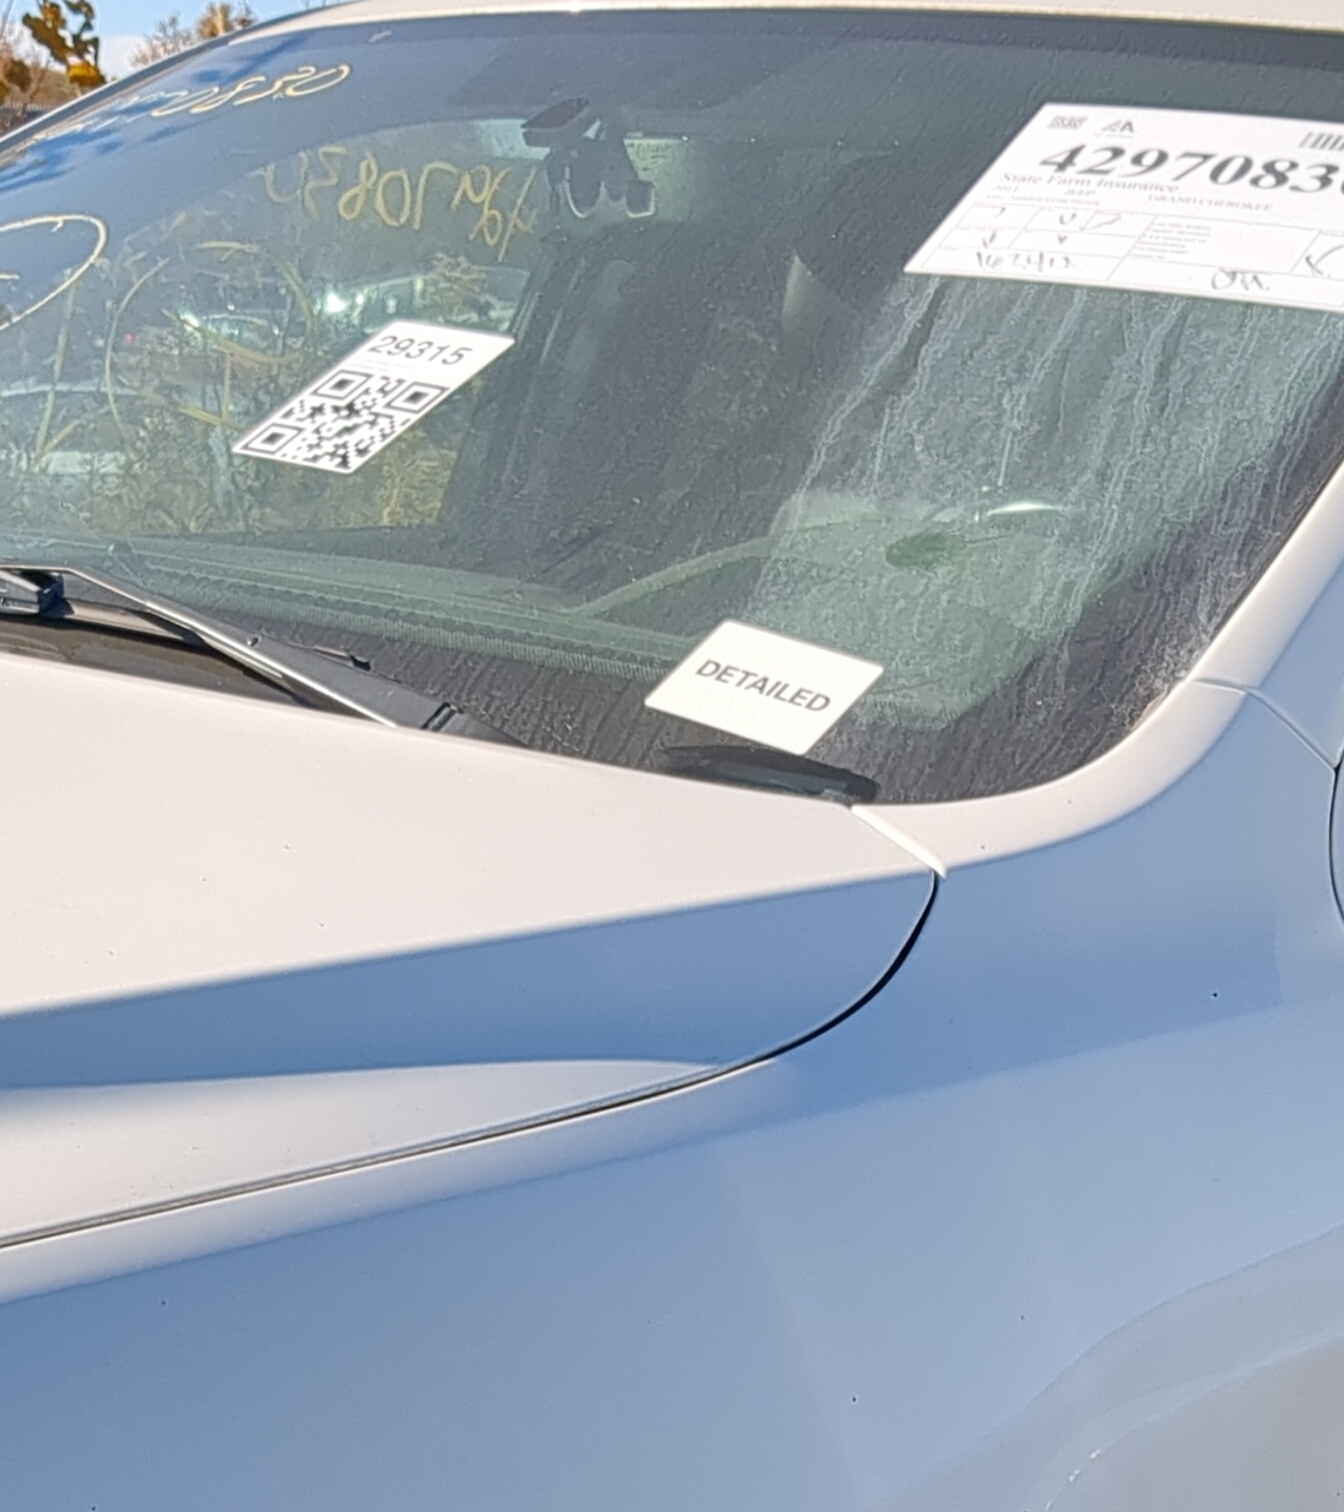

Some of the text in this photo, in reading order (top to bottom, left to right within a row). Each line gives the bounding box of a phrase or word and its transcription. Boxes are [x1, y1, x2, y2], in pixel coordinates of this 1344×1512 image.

[1000, 172, 1180, 194] State Farm Insurance
[366, 334, 475, 366] 29315
[695, 659, 832, 712] DETAILED
